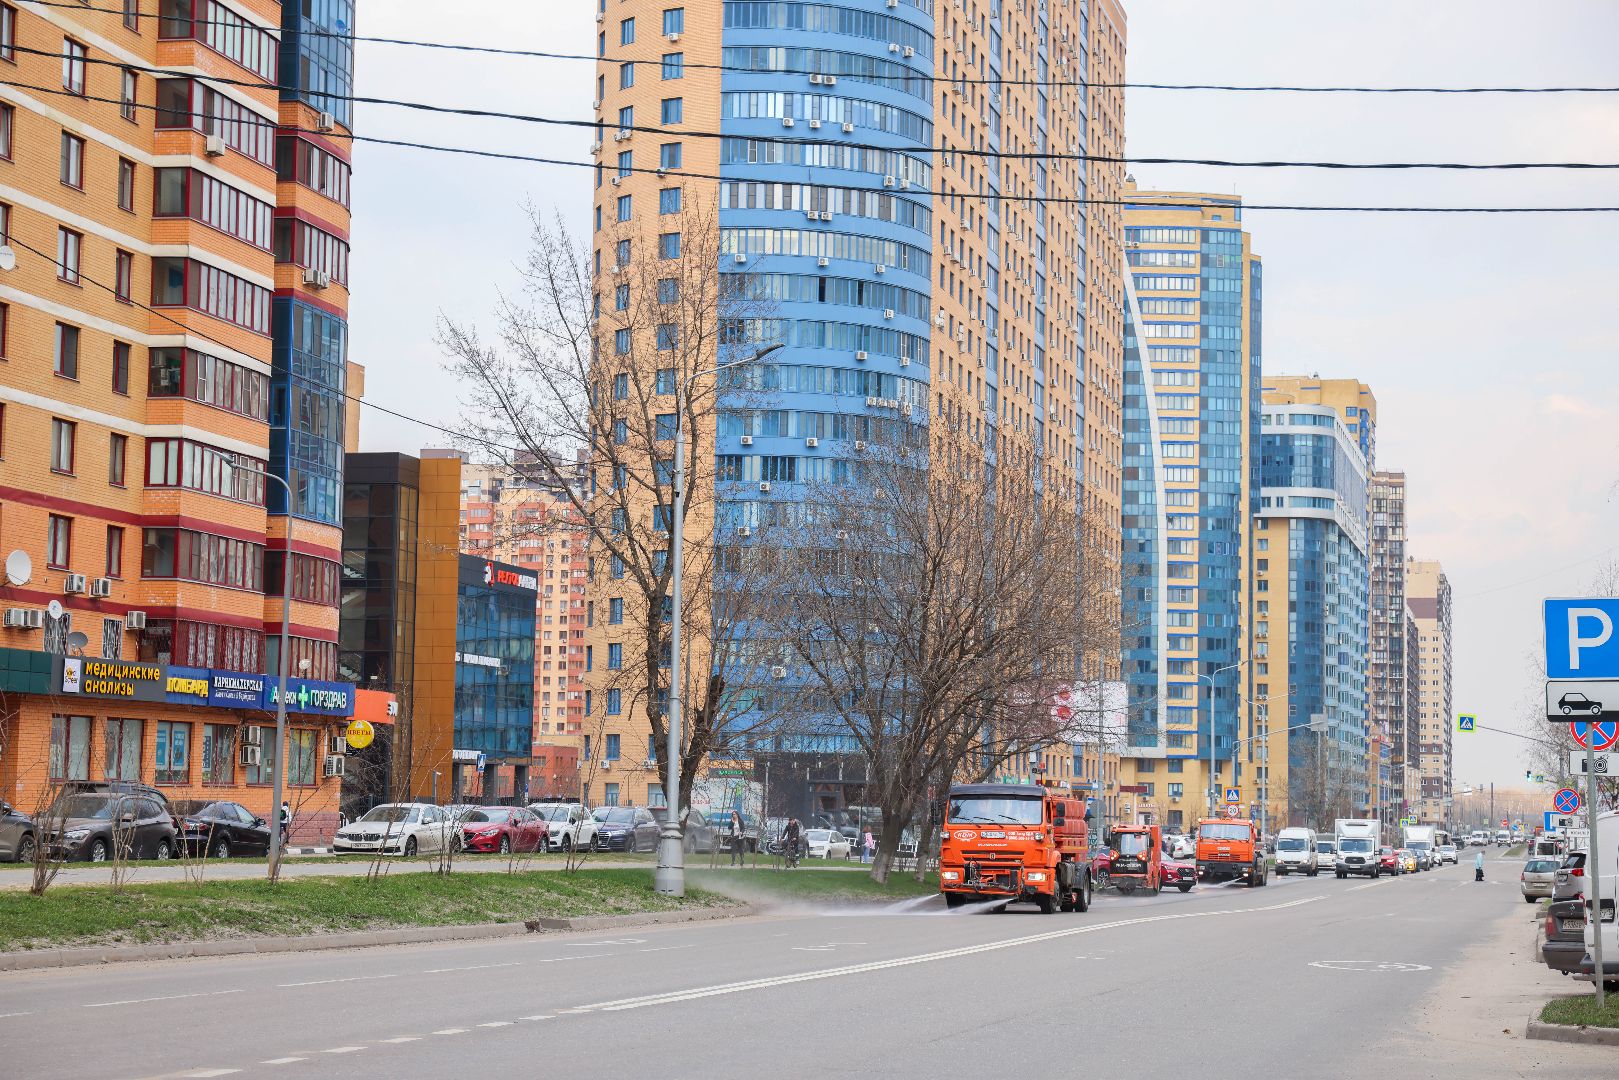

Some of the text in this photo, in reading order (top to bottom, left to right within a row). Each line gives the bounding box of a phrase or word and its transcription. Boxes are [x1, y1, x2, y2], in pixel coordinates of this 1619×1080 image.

[1567, 607, 1614, 670] P
[166, 677, 209, 697] ЛОМБАРД
[310, 690, 347, 710] ГОРЗДРАВ
